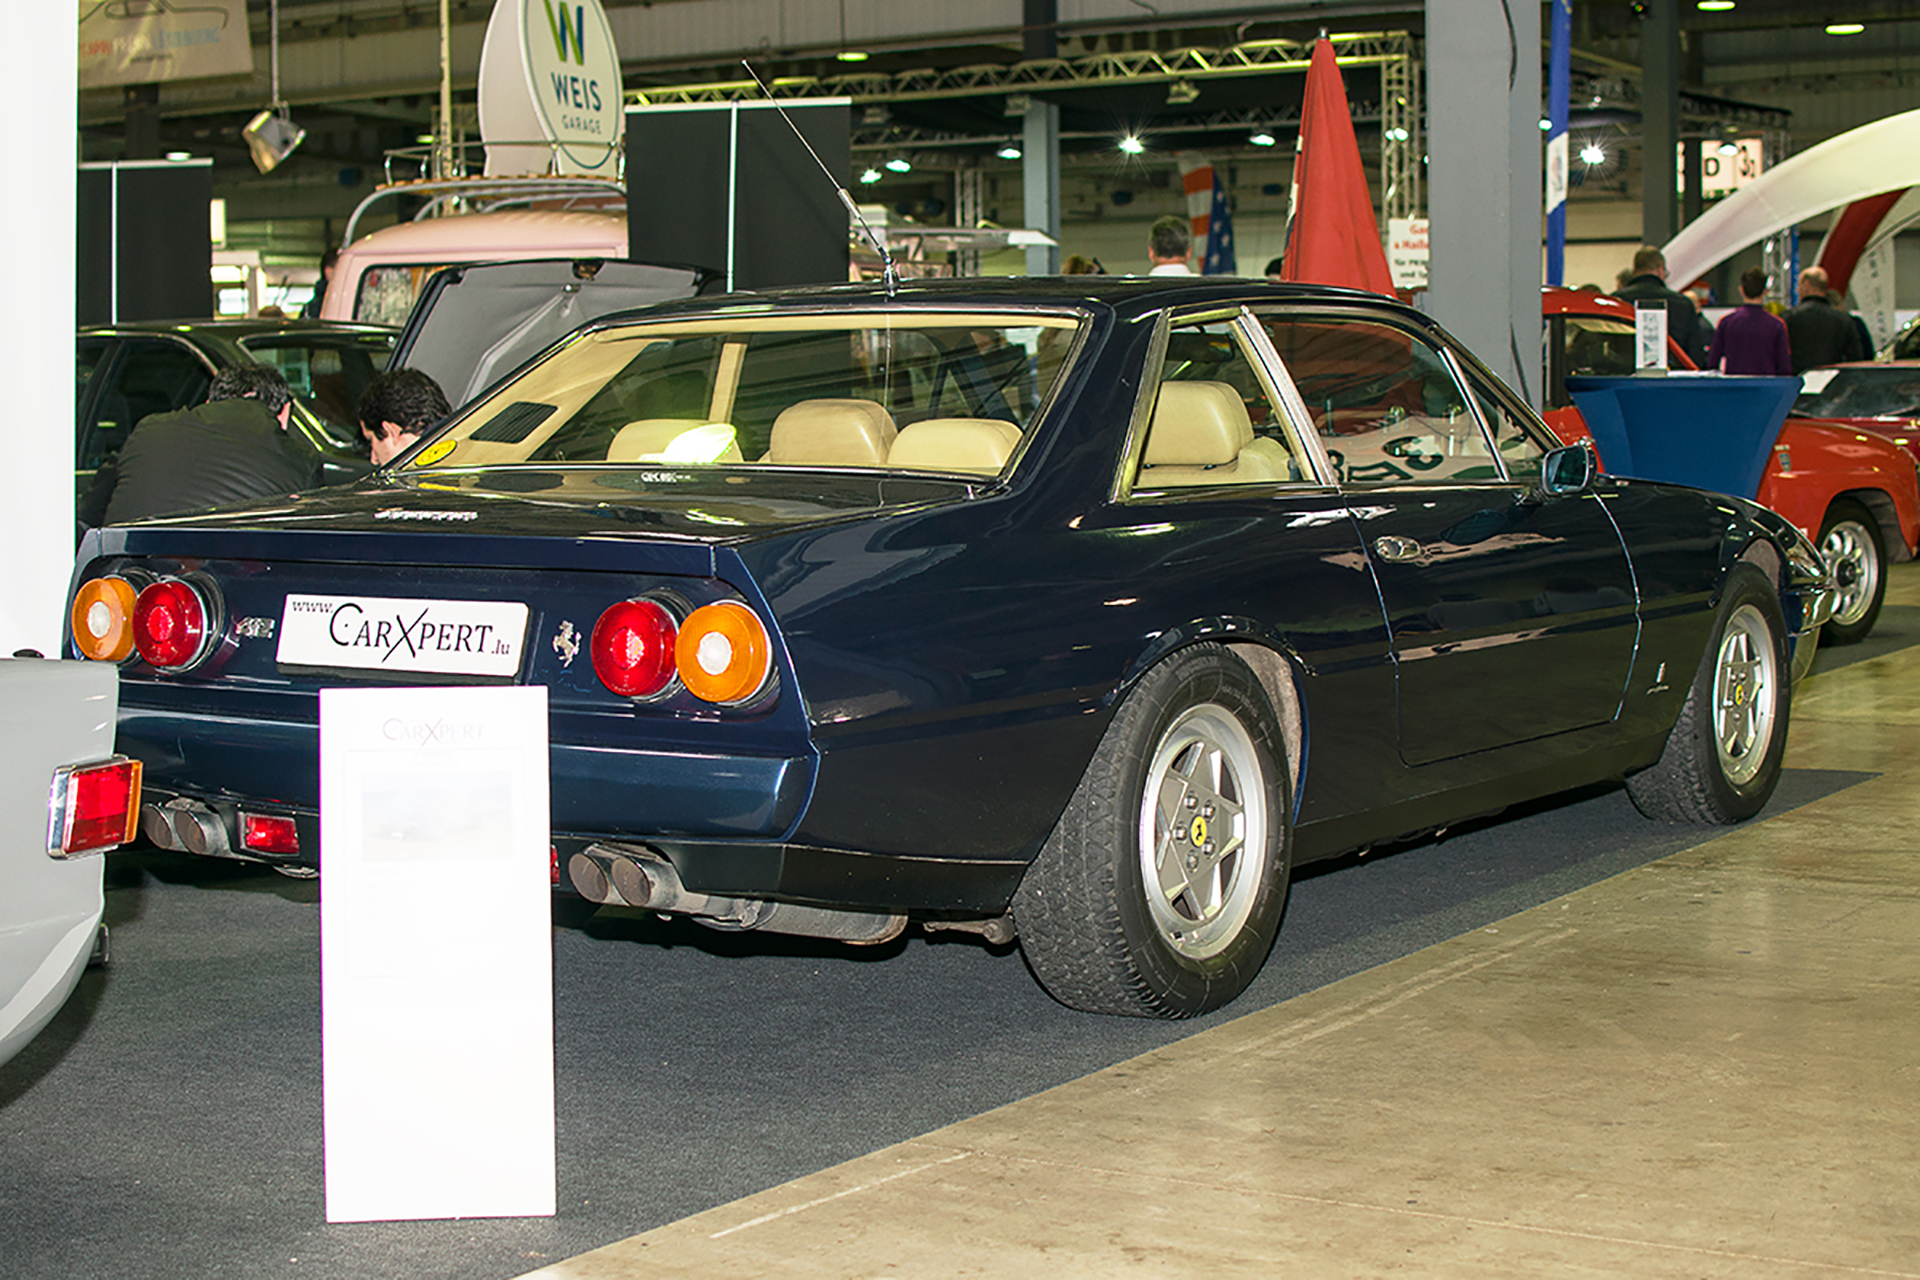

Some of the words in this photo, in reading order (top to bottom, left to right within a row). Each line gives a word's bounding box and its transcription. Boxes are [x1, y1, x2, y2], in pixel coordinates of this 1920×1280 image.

[550, 71, 602, 112] WEIS
[561, 114, 602, 135] GARAGE
[1705, 157, 1720, 176] D
